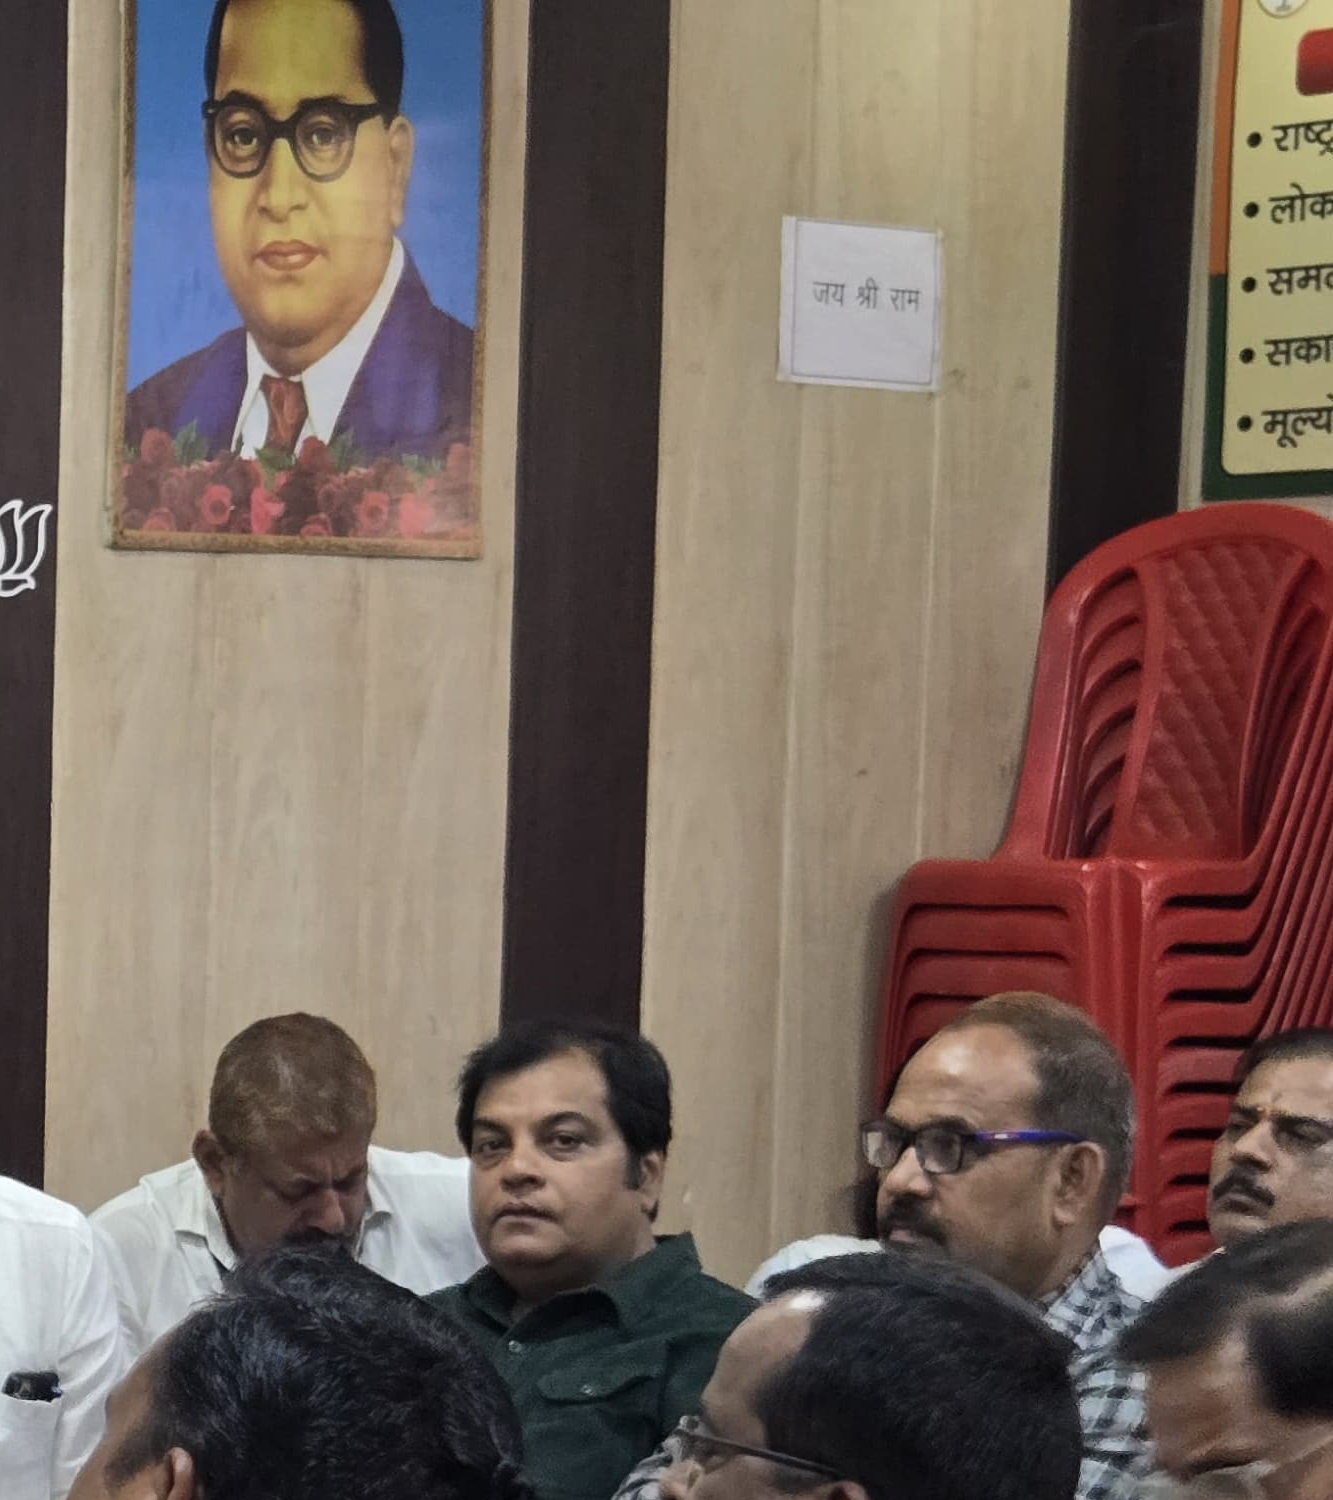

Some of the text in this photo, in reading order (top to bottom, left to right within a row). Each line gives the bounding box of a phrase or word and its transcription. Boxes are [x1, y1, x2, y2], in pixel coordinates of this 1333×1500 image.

[812, 277, 921, 313] जय श्री राम
